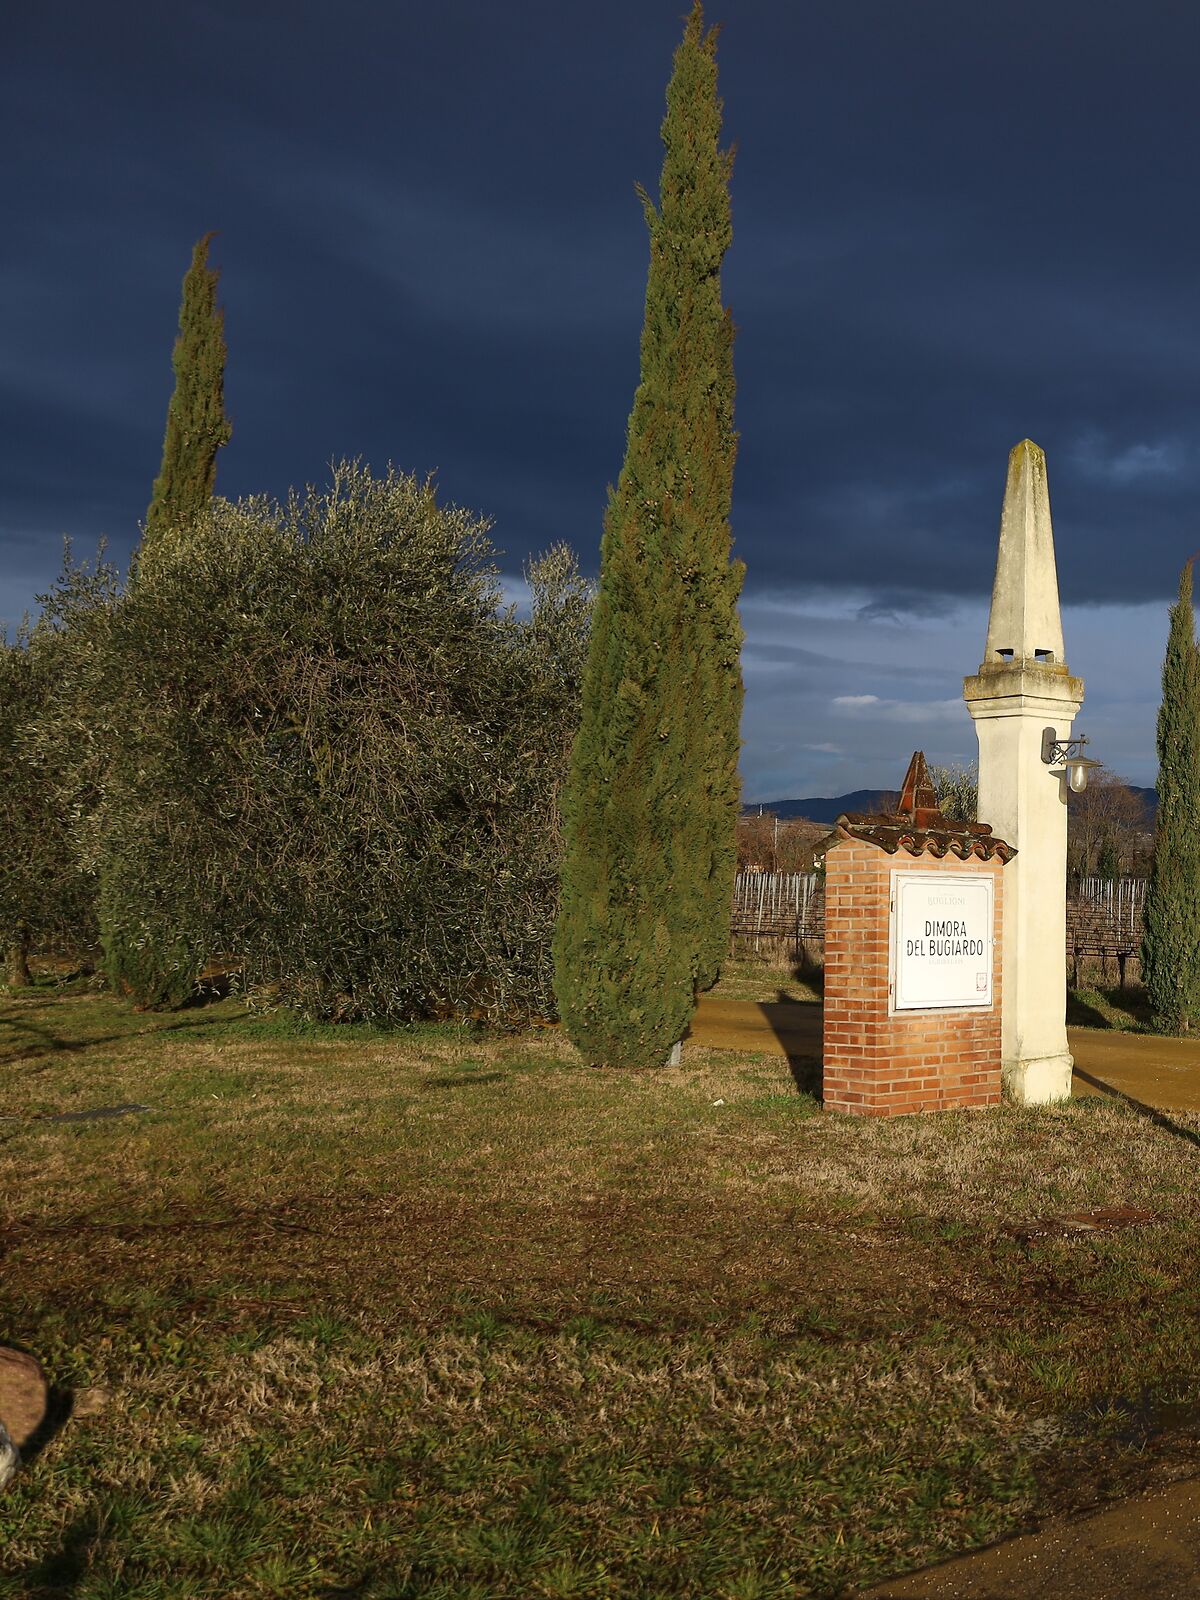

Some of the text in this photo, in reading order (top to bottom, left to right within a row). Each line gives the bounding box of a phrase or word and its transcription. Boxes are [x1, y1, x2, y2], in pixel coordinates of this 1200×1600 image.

[925, 921, 967, 937] DIMORA
[906, 939, 984, 956] DEL BUGIARDO
